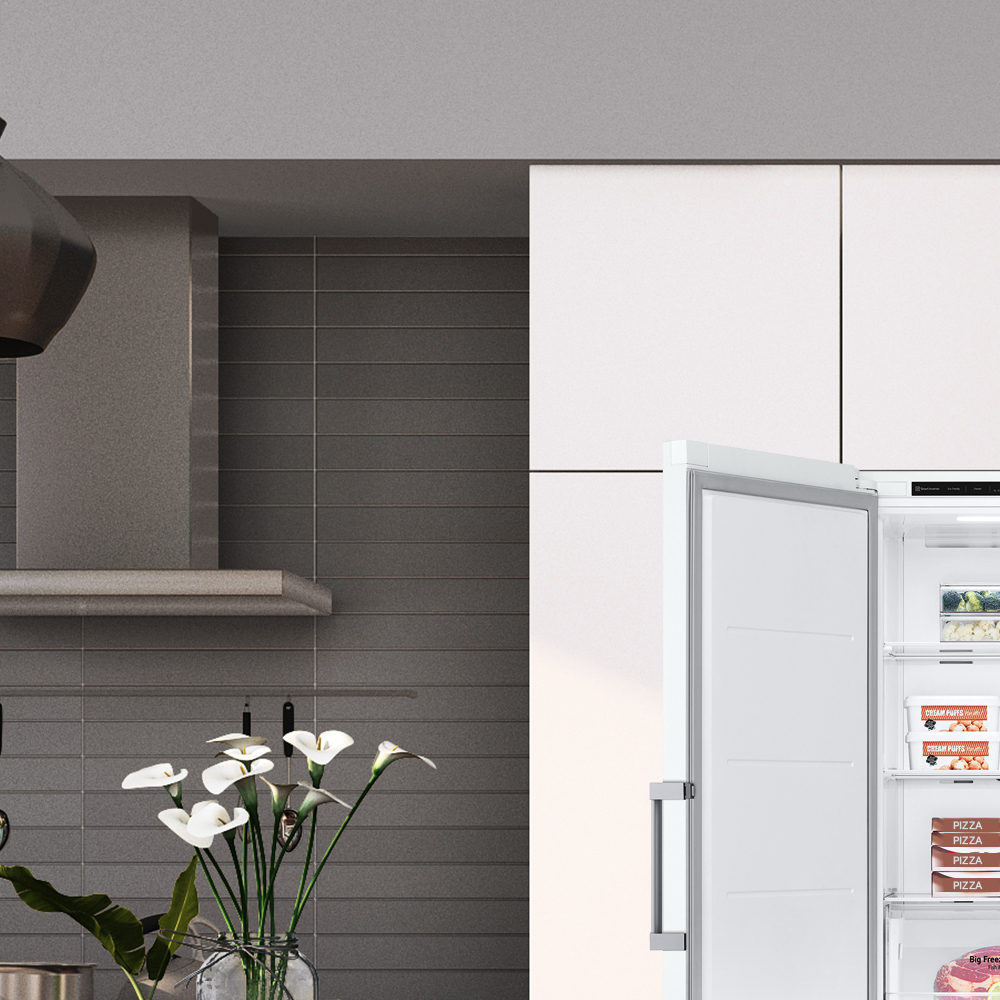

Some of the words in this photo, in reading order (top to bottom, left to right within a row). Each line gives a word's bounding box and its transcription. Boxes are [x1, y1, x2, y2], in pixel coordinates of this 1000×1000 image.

[953, 821, 982, 830] PIZZA
[953, 836, 982, 844] PIZZA
[953, 856, 982, 864] PIZZA
[953, 881, 982, 890] PIZZA
[970, 956, 981, 965] Big
